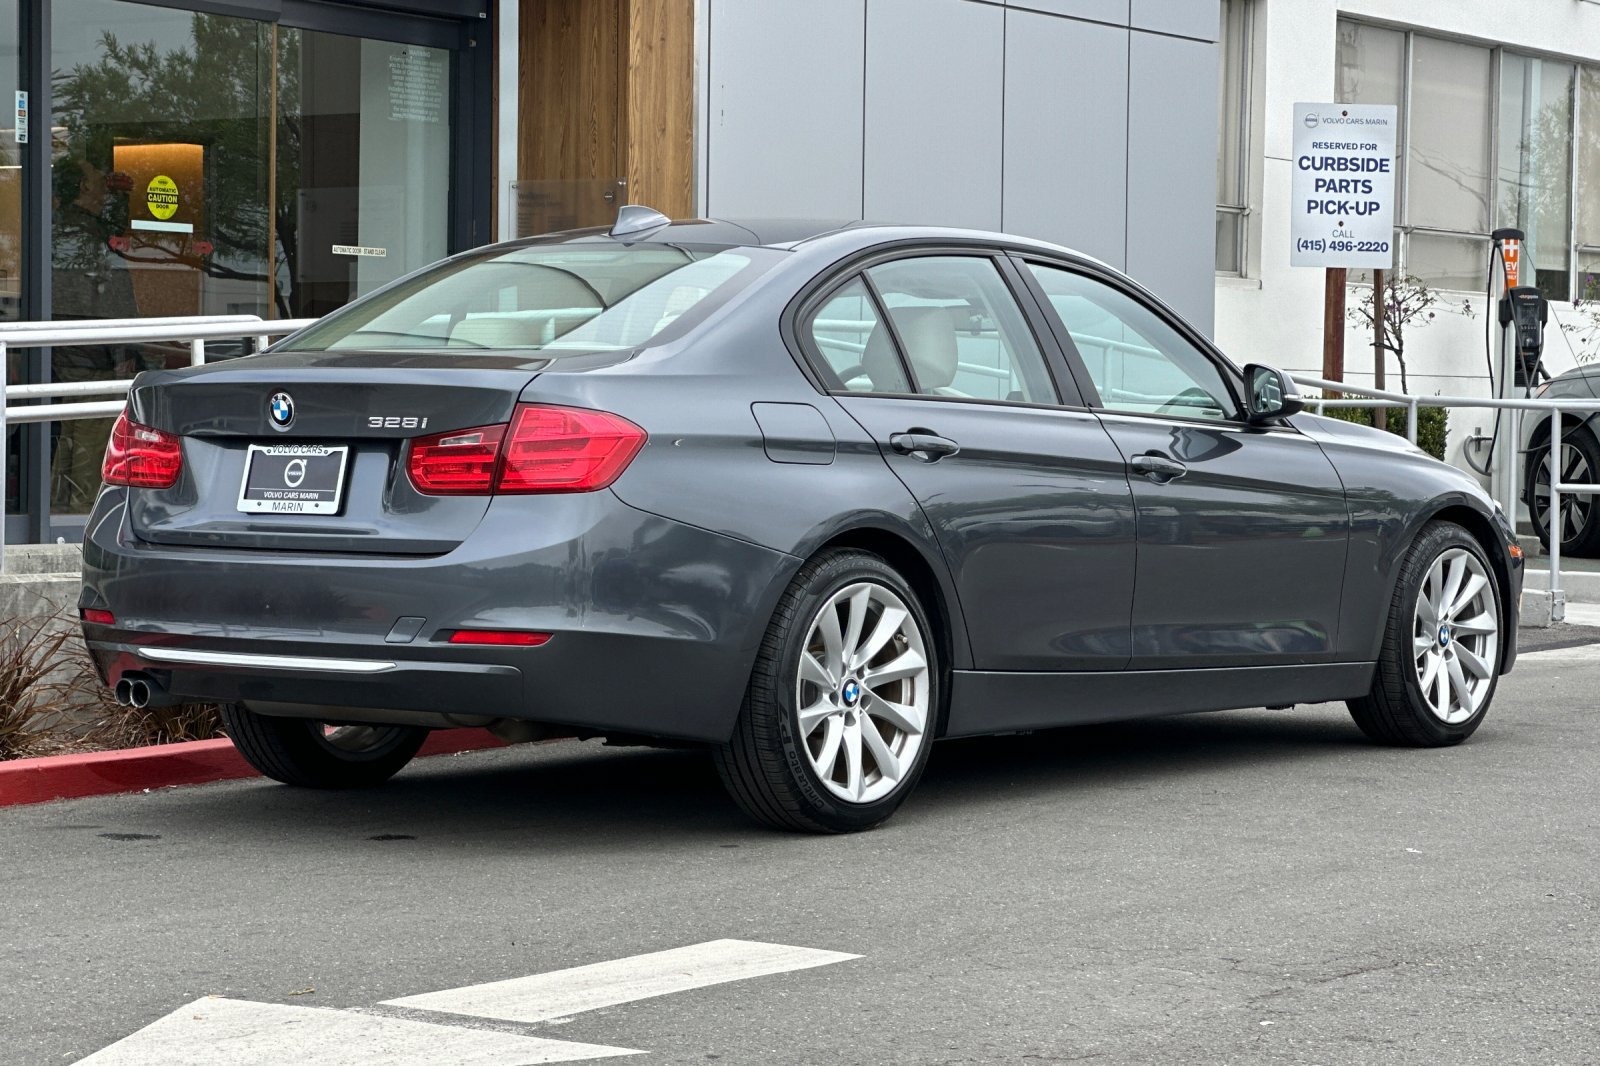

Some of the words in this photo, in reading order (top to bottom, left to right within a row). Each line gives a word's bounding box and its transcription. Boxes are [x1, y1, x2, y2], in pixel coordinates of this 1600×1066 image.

[1345, 117, 1365, 125] CARS
[1365, 118, 1388, 126] MARIN
[1312, 141, 1359, 151] RESERVED
[1359, 143, 1378, 151] FOR
[1298, 155, 1390, 173] CURBSIDE
[1314, 178, 1373, 194] PARTS
[148, 194, 178, 203] CAUTION
[1307, 199, 1381, 216] PICK-UP
[1332, 229, 1355, 239] CALL
[1296, 237, 1327, 253] (415)
[1329, 240, 1389, 253] 496-2220
[1505, 261, 1517, 271] EV
[272, 444, 300, 454] VOLVO
[300, 444, 324, 455] CARS
[263, 491, 283, 499] VOLVO
[283, 491, 299, 499] CARS
[299, 491, 319, 500] MARIN
[272, 501, 304, 511] MARIN
[779, 702, 793, 745] P7
[788, 750, 825, 810] Cinturato
